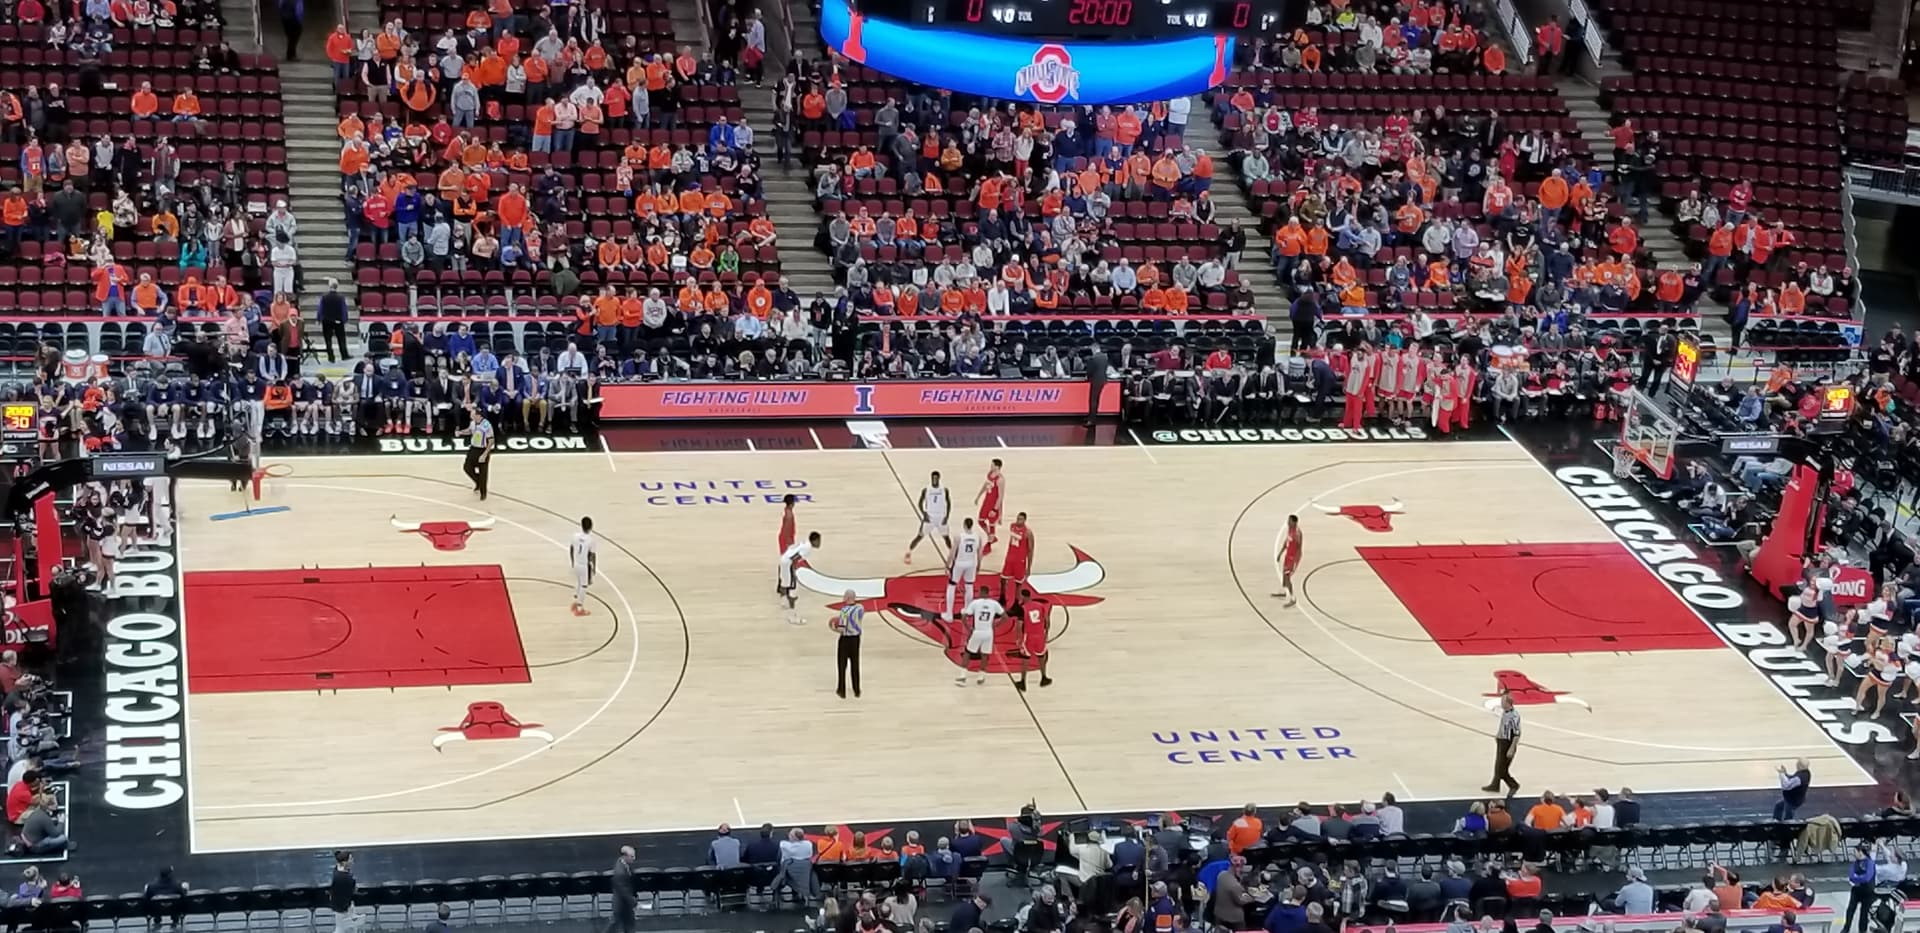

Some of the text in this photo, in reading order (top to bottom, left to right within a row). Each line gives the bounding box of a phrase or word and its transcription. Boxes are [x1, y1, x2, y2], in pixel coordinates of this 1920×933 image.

[1233, 3, 1250, 28] 0
[661, 389, 809, 406] FIGHTING ILLINI
[854, 384, 875, 414] I
[920, 387, 1063, 404] FIGHTING ILLINI
[1152, 427, 1427, 442] @CHICAGOBULLS
[379, 436, 587, 452] BULL.COM
[103, 462, 155, 472] NISSAN
[640, 479, 809, 491] UNITED
[647, 494, 816, 505] CENTER
[1554, 466, 1899, 744] CHICAGO BULLS
[978, 611, 991, 622] 23
[104, 612, 184, 809] CHICAGO
[1152, 726, 1341, 744] UNITED
[1167, 746, 1357, 764] CENTER
